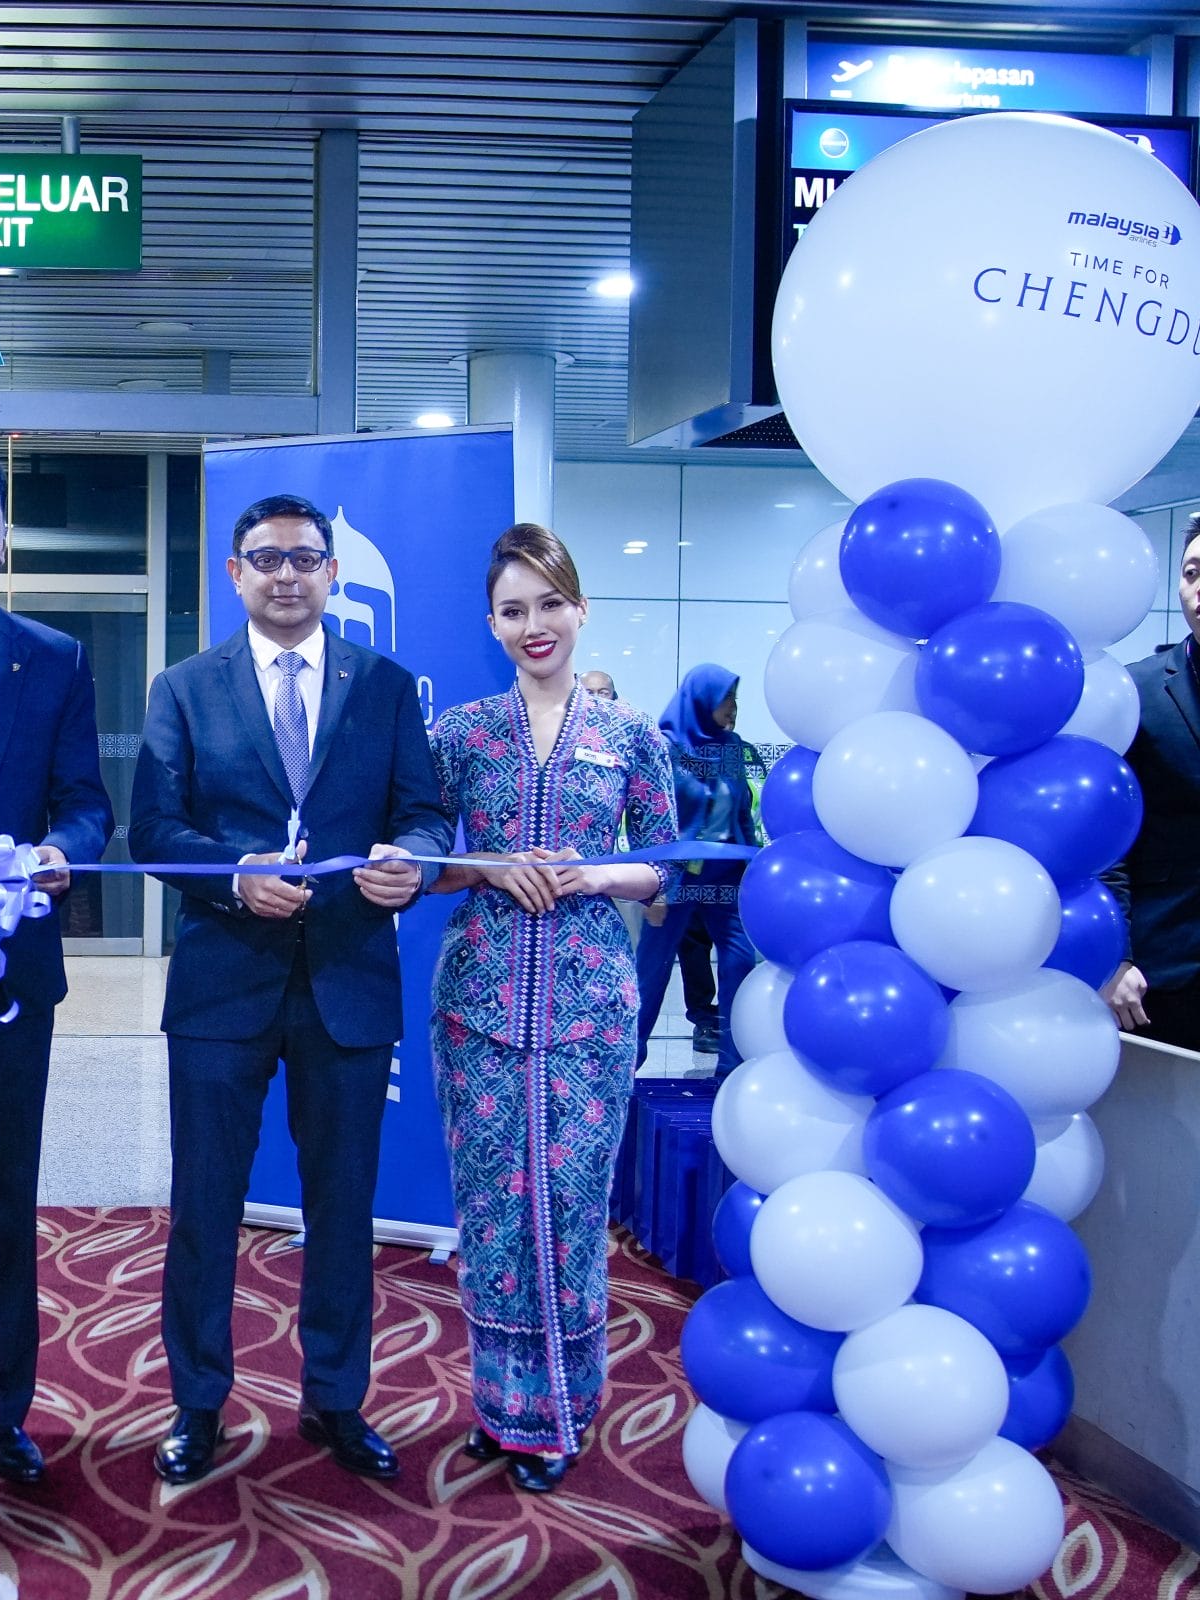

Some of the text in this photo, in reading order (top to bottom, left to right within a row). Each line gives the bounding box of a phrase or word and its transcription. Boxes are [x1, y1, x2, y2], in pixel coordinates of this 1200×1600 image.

[1067, 211, 1160, 240] malaysia
[1128, 234, 1158, 248] airlines
[1069, 251, 1170, 290] TIME FOR
[973, 267, 1200, 356] CHENGD
